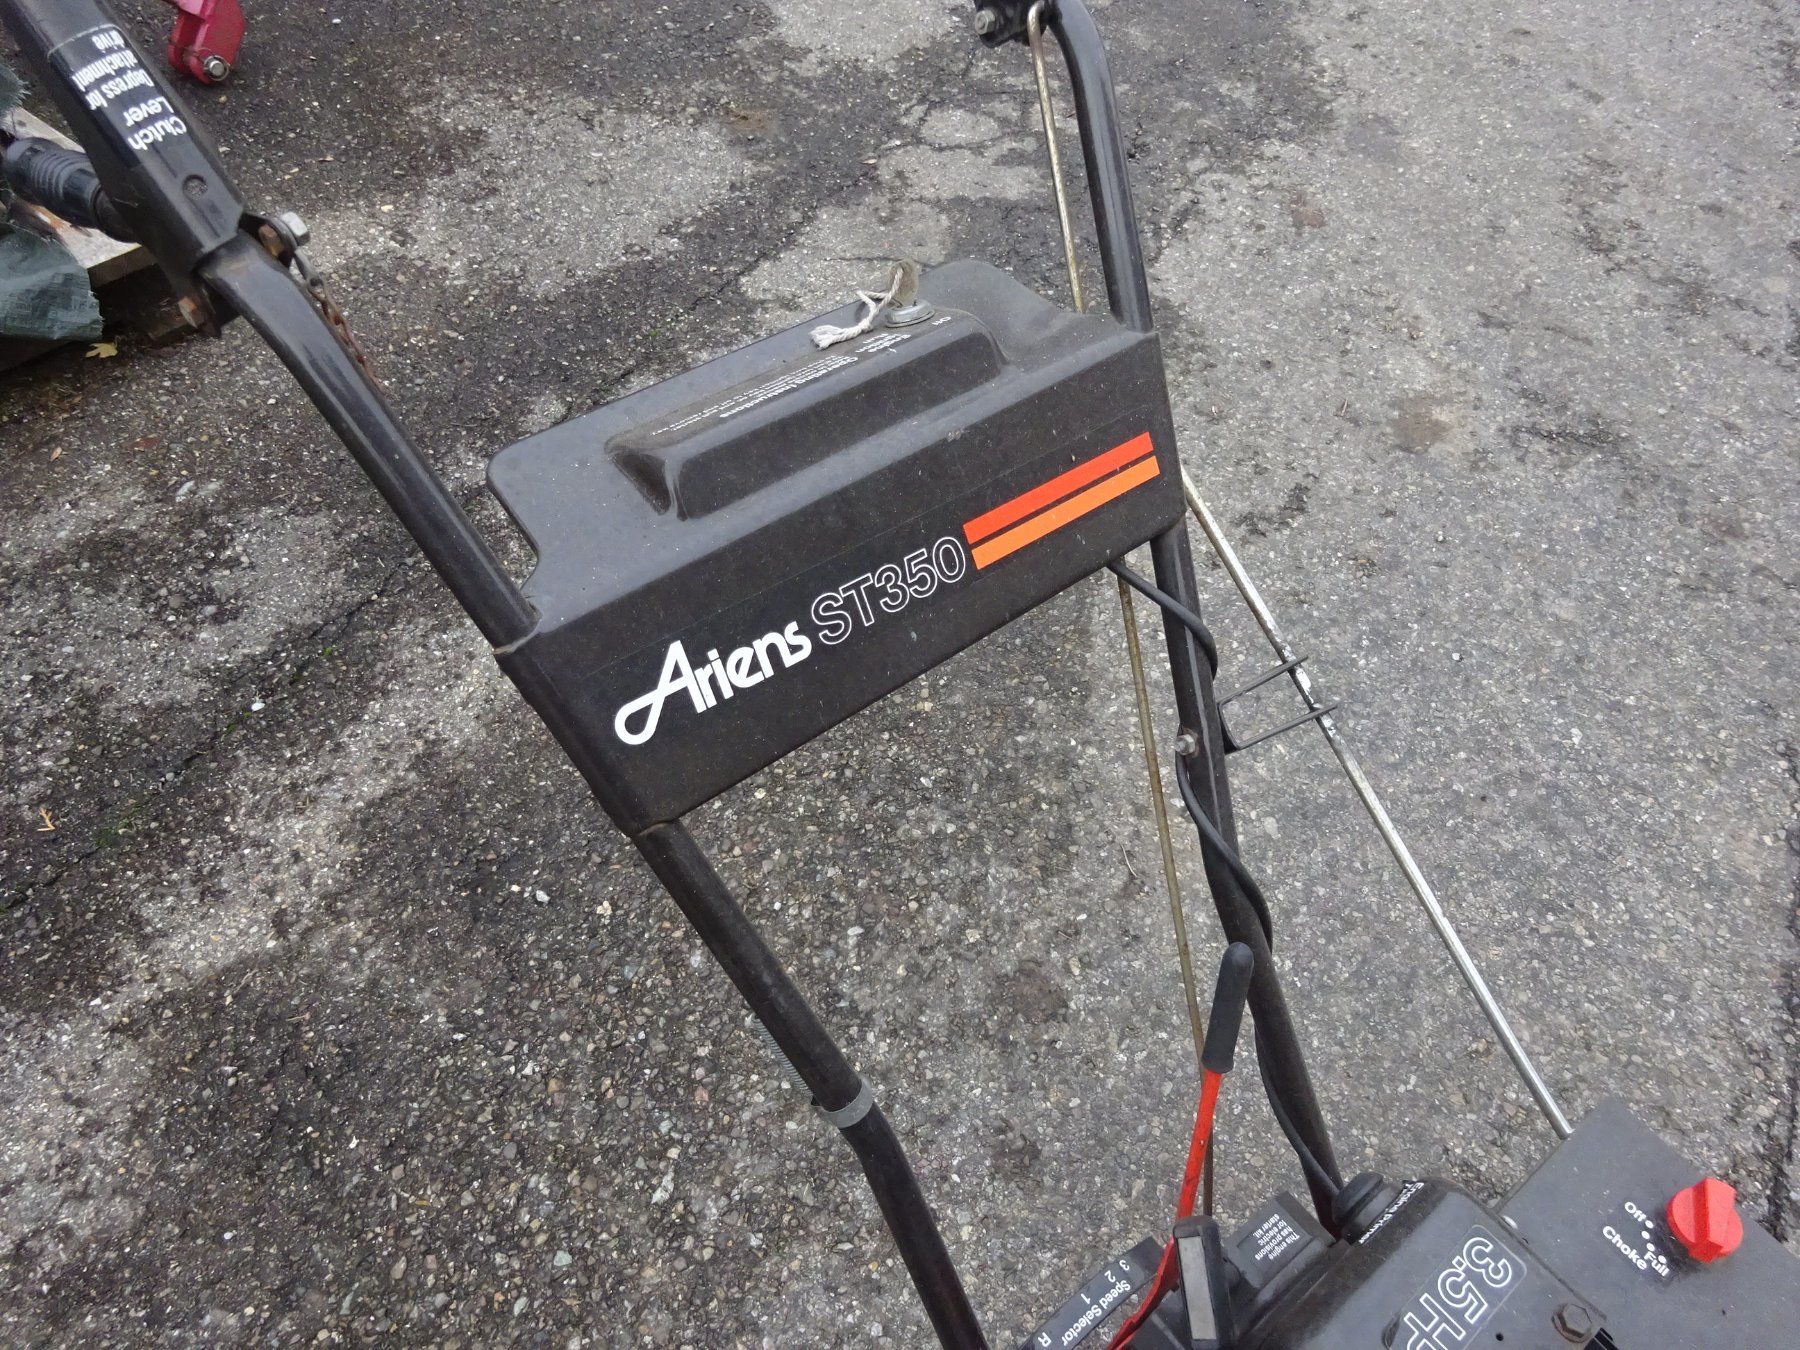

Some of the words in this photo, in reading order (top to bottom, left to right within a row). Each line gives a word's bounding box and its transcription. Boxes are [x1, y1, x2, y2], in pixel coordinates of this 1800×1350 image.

[91, 29, 125, 53] drive
[72, 49, 138, 92] attachment
[100, 68, 155, 99] Depress
[85, 89, 108, 111] for
[123, 96, 174, 127] Lever
[128, 116, 187, 150] Clutch
[614, 621, 812, 745] Ariens
[811, 537, 966, 645] ST350
[1624, 1201, 1647, 1222] Off
[1286, 1231, 1300, 1244] This
[1602, 1225, 1648, 1270] Choke
[1104, 1270, 1116, 1283] 2
[1119, 1259, 1130, 1271] 3
[1643, 1251, 1670, 1277] Full
[1080, 1293, 1091, 1305] 1
[1099, 1279, 1131, 1310] Speed
[1061, 1304, 1102, 1346] Selector
[1037, 1332, 1052, 1348] R
